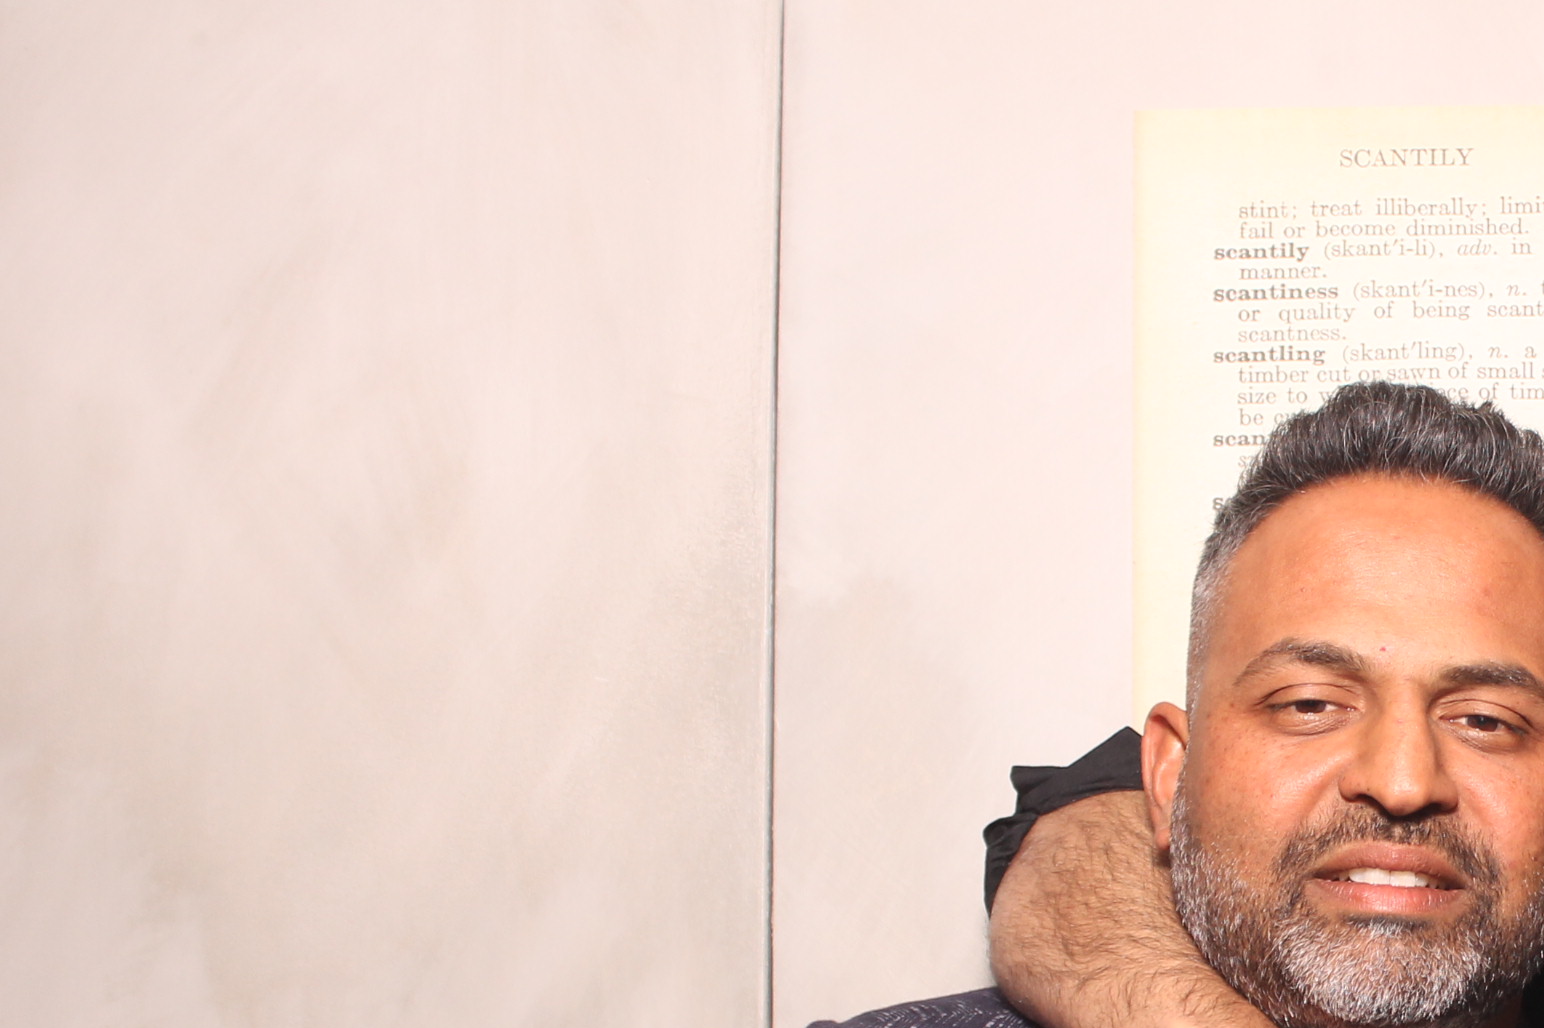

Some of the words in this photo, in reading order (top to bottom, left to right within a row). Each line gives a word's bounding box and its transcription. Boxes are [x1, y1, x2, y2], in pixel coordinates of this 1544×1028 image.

[1339, 148, 1474, 169] SCANTILY
[1239, 200, 1297, 219] stint;
[1311, 200, 1362, 216] treat
[1376, 198, 1487, 218] illiberally;
[1240, 221, 1274, 239] fail
[1283, 225, 1306, 239] or
[1315, 219, 1396, 237] become
[1406, 218, 1530, 236] diminished.
[1213, 242, 1310, 262] scantily
[1457, 239, 1498, 256] adv.
[1511, 237, 1533, 255] in
[1239, 266, 1327, 280] manner.
[1213, 283, 1339, 302] scantiness
[1506, 284, 1528, 296] n.
[1238, 308, 1262, 322] or
[1278, 301, 1356, 324] quality
[1373, 301, 1396, 319] of
[1412, 299, 1470, 320] being
[1238, 326, 1347, 343] scantness.
[1213, 344, 1326, 365] scantling
[1489, 346, 1508, 359] n.
[1524, 345, 1537, 359] a
[1238, 365, 1309, 383] timber
[1316, 366, 1352, 383] cut
[1386, 366, 1441, 381] sawn
[1448, 361, 1469, 379] of
[1476, 361, 1534, 380] small
[1237, 386, 1277, 405] size
[1287, 387, 1308, 404] to
[1478, 382, 1500, 400] of
[1239, 408, 1264, 426] be
